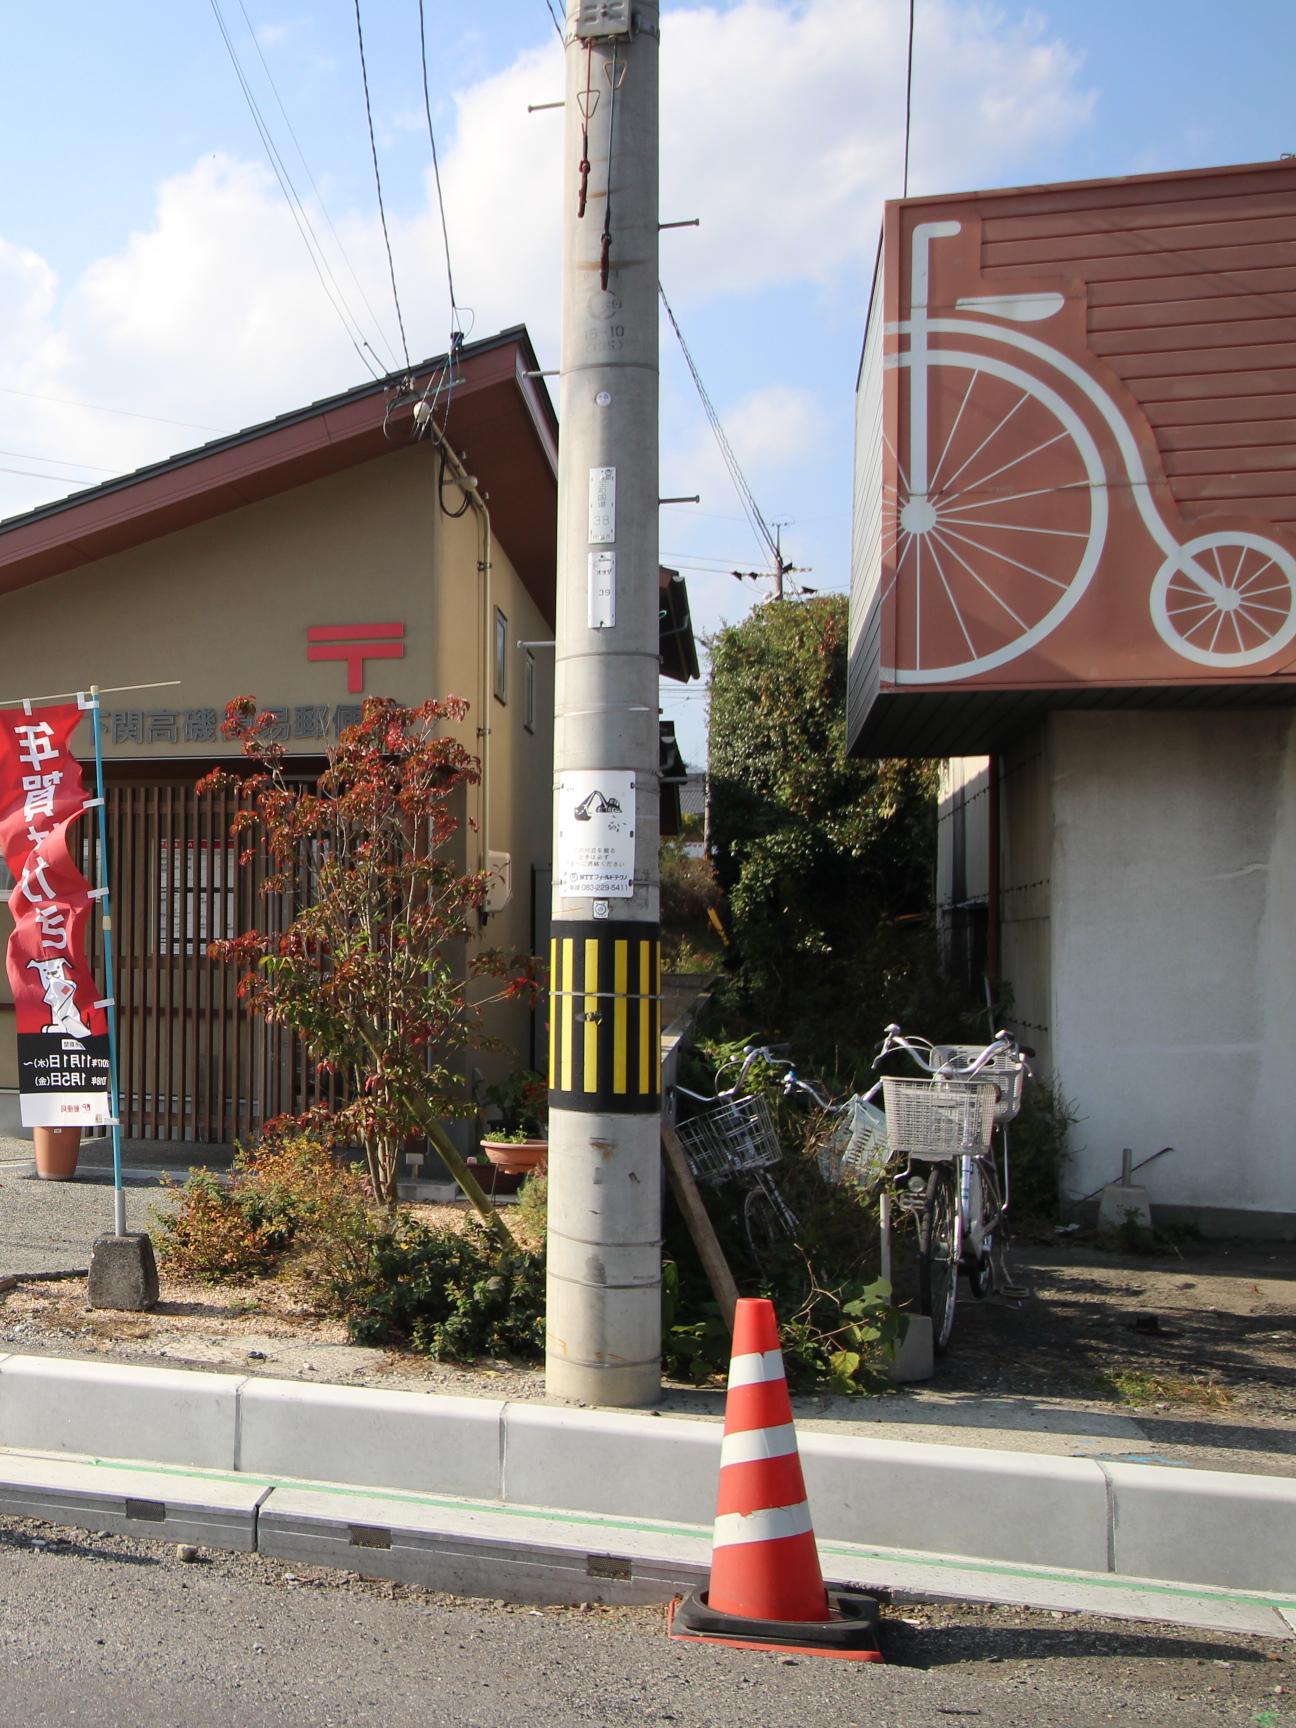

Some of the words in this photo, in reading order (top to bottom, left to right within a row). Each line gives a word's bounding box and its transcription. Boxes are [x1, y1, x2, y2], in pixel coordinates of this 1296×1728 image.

[593, 515, 610, 526] 38
[598, 589, 611, 597] 39
[82, 702, 406, 746] 下関高磯簡易郵便
